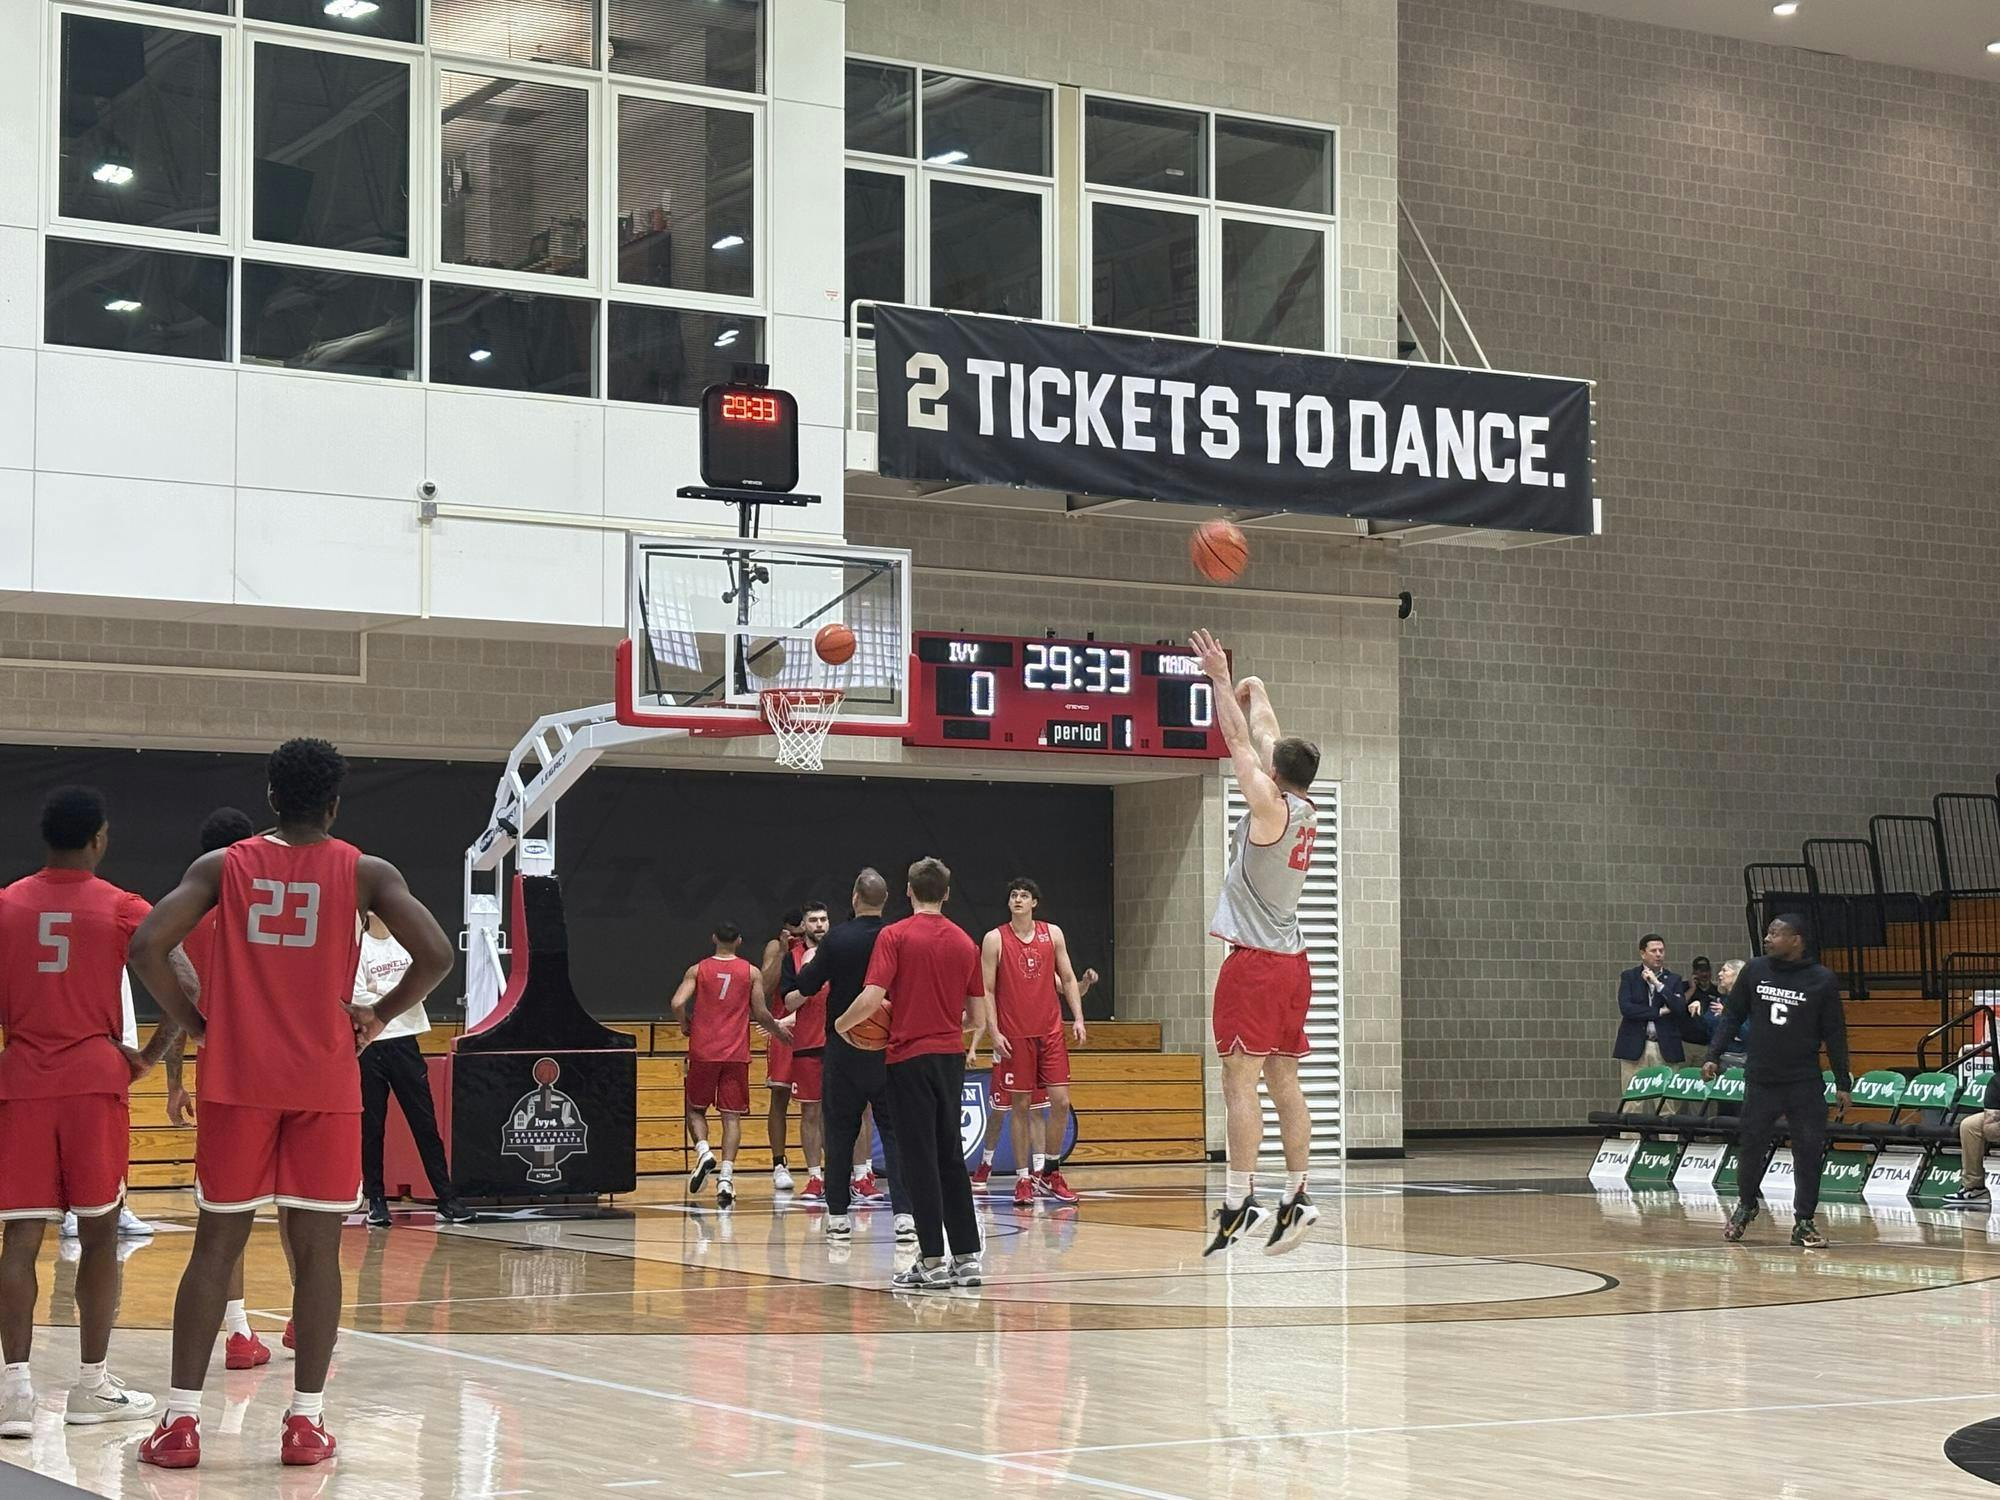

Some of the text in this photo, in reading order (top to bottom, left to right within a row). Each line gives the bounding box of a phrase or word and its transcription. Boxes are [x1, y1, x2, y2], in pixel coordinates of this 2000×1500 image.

[723, 395, 776, 421] 29:33
[905, 352, 1567, 488] 2 TICKETS TO DANCE.
[949, 642, 979, 663] IVY
[1024, 644, 1132, 694] 29:33
[971, 670, 996, 716] 0
[1190, 683, 1213, 727] 0
[1054, 723, 1102, 744] period
[1125, 719, 1132, 747] 1
[247, 878, 321, 948] 23
[38, 912, 73, 973] 5
[717, 973, 731, 1000] 7
[1756, 985, 1807, 1002] CORNELL
[1770, 1002, 1788, 1025] C
[791, 1082, 798, 1094] C
[1005, 1073, 1014, 1085] C
[1627, 1075, 1653, 1094] Ivy
[1668, 1073, 1694, 1095] Ivy
[1713, 1074, 1739, 1096] Ivy
[1852, 1077, 1884, 1100] Ivy
[1905, 1079, 1936, 1102] Ivy
[535, 1118, 550, 1128] Ivy
[1608, 1152, 1629, 1165] TIAA
[1637, 1151, 1662, 1169] Ivy
[1693, 1157, 1717, 1170] TIAA
[1725, 1155, 1739, 1170] Iv
[1823, 1160, 1851, 1181] Ivy
[1884, 1168, 1911, 1181] TIAA
[1927, 1166, 1953, 1185] Ivy
